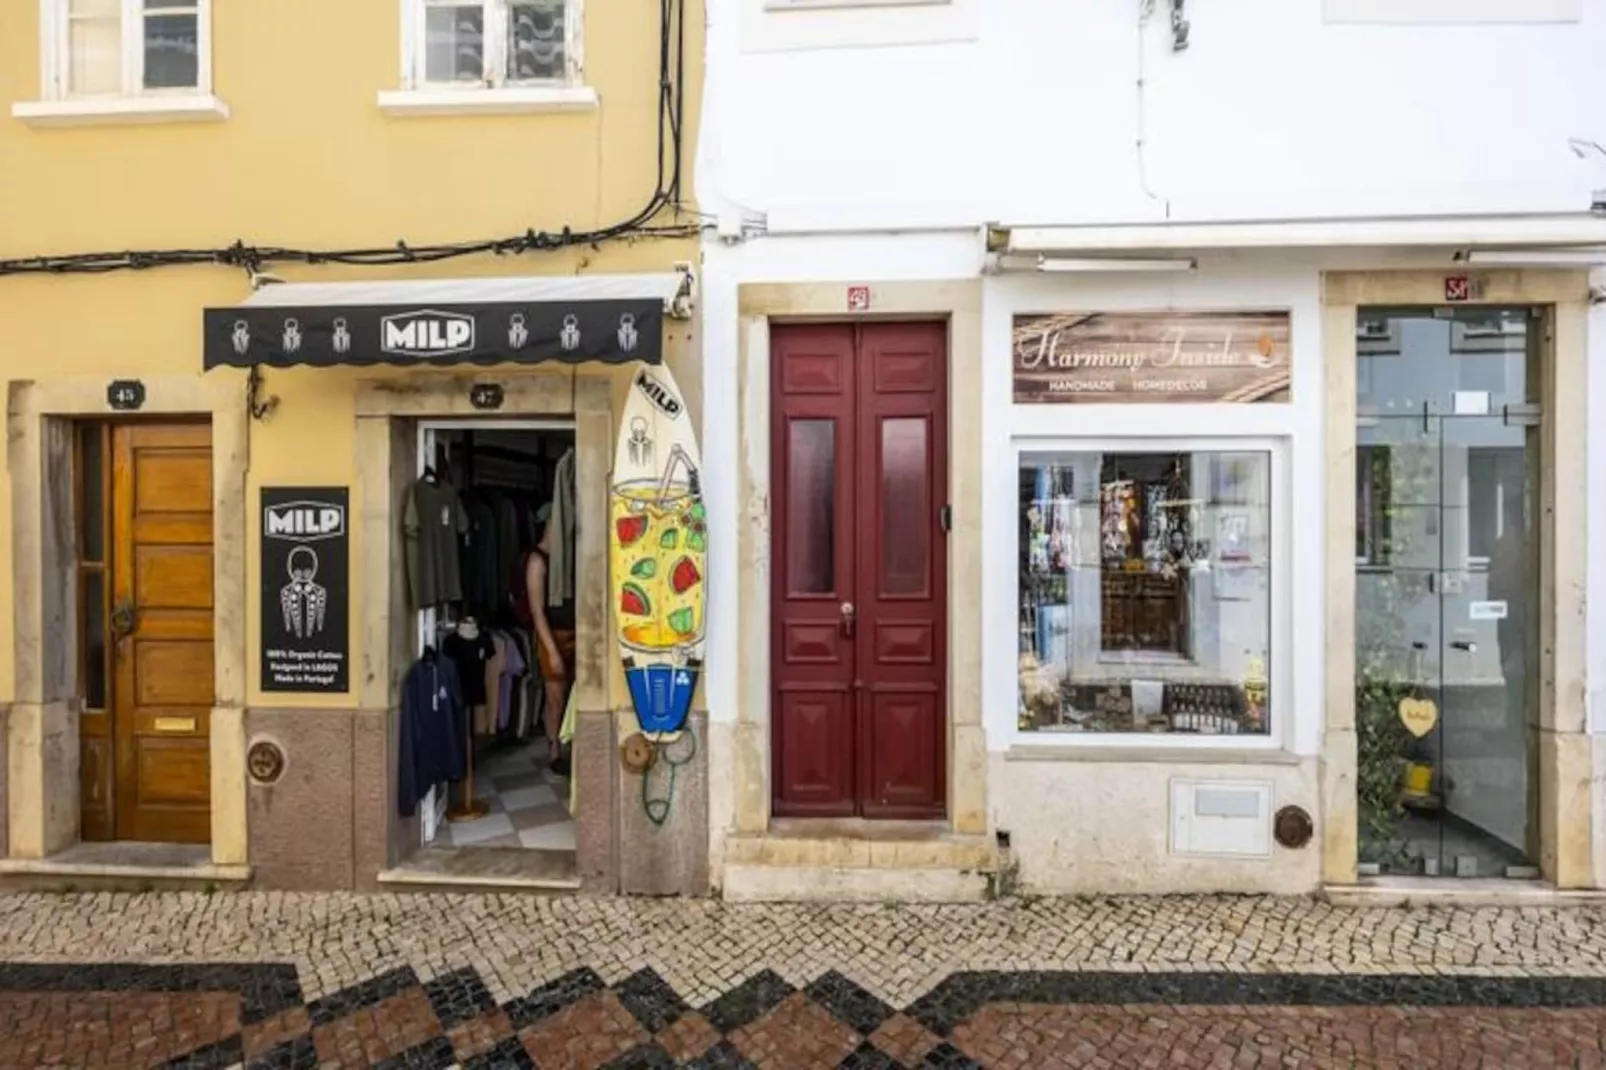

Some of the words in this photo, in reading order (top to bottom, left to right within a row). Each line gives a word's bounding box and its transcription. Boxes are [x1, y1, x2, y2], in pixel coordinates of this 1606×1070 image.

[386, 319, 470, 349] MILP
[1017, 325, 1144, 372] Harmony
[1151, 326, 1240, 368] Inside
[636, 370, 679, 413] MILP
[1048, 379, 1116, 391] HANDMADE
[1132, 379, 1207, 391] HOMEDECOR
[268, 508, 341, 534] MILP
[288, 649, 316, 660] Organic
[317, 649, 343, 660] Cotton
[270, 661, 302, 672] Designed
[303, 662, 310, 671] in
[312, 662, 338, 672] LAGOS
[274, 674, 294, 682] Made
[295, 674, 302, 682] in
[303, 673, 334, 685] Portugal
